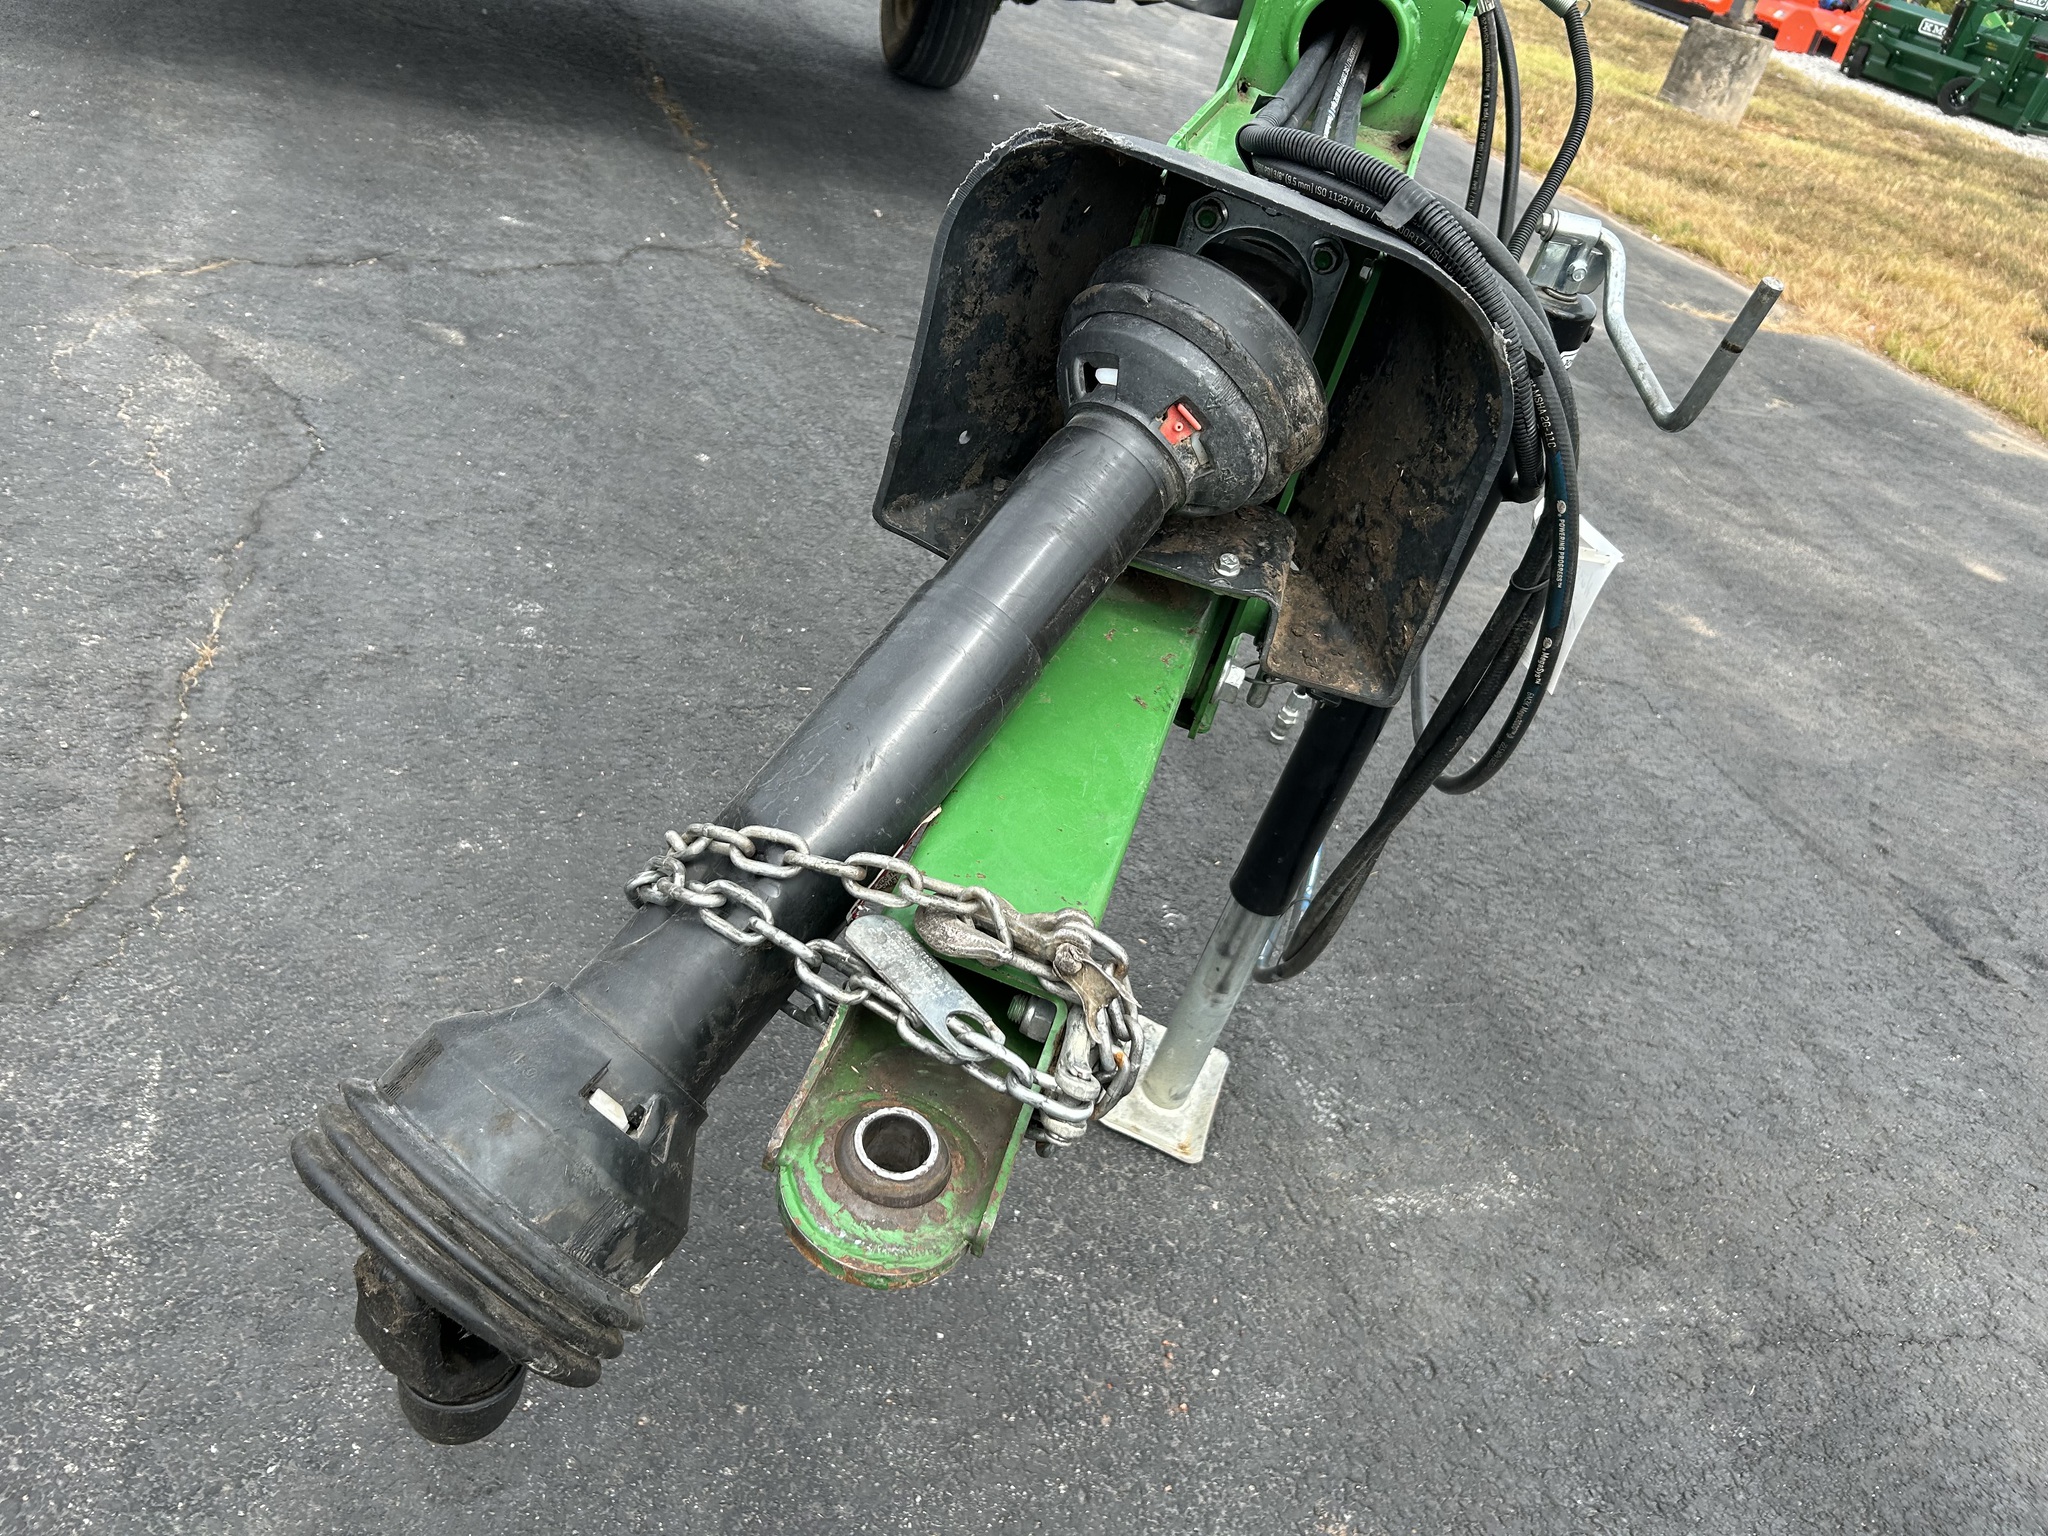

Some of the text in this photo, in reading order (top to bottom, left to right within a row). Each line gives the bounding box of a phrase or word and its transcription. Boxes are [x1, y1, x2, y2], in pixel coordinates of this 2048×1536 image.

[1328, 190, 1353, 207] 11237
[1354, 199, 1371, 214] R17
[1532, 389, 1547, 415] MSHA
[1558, 518, 1566, 551] POWERING
